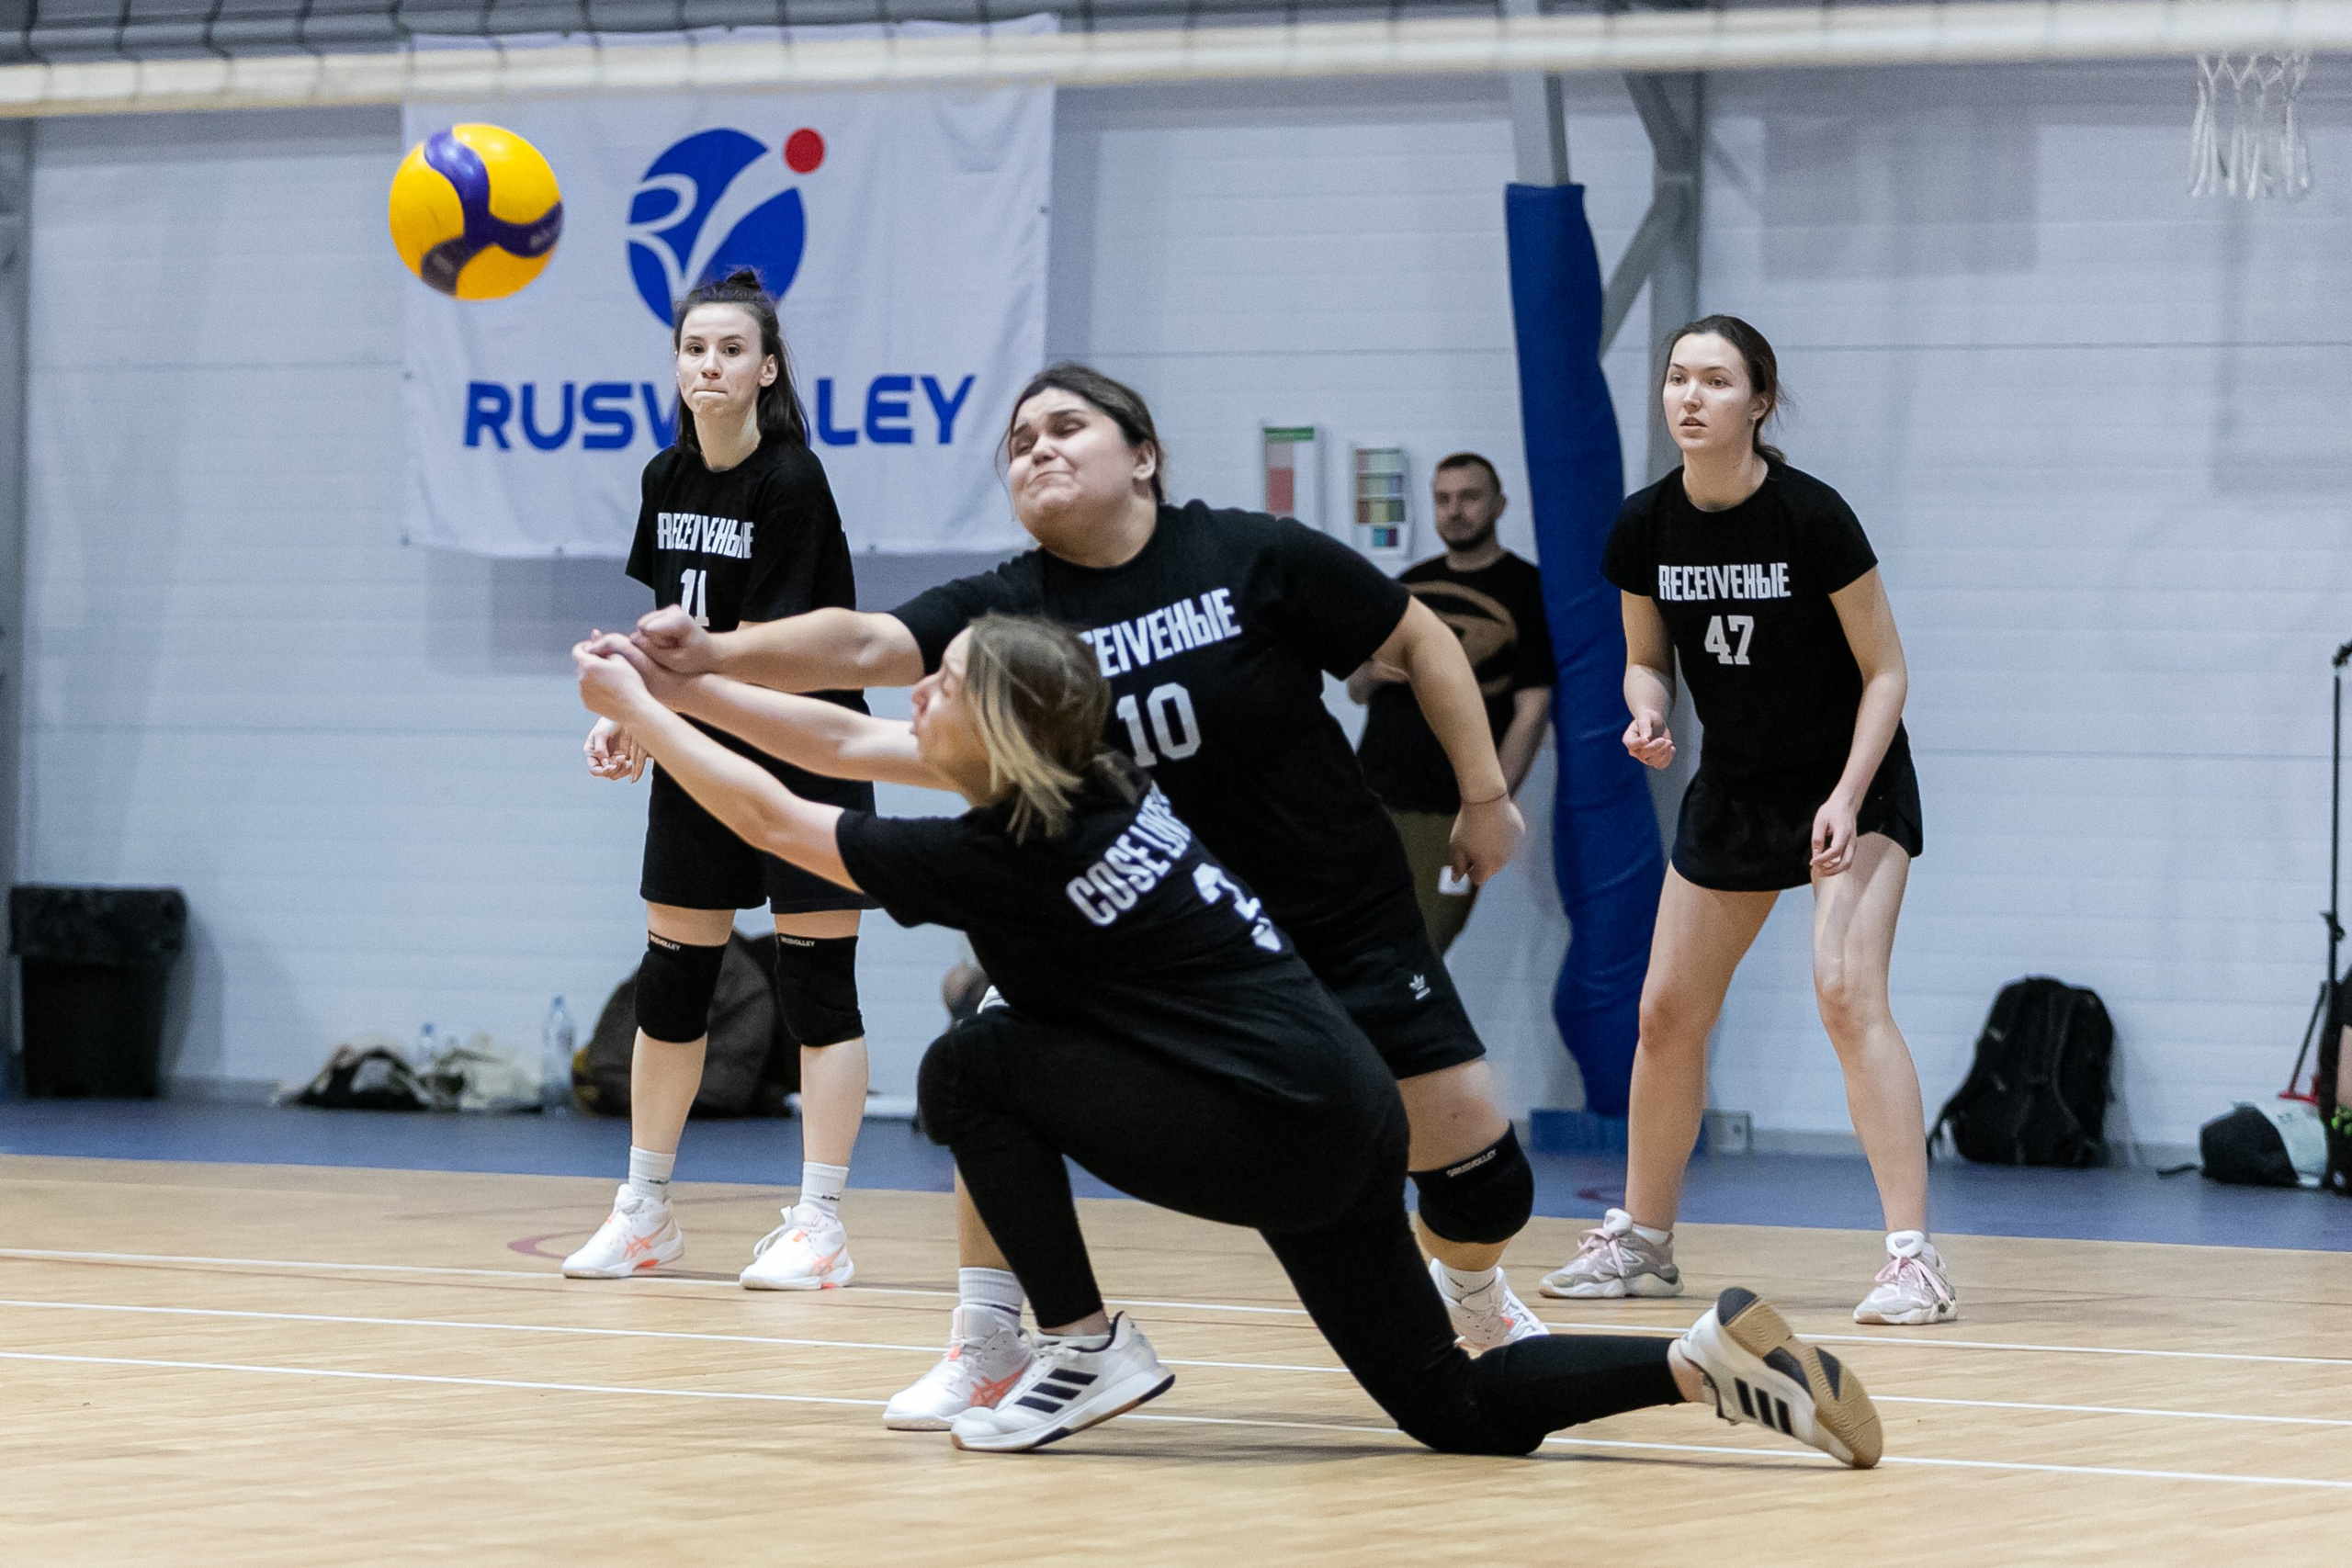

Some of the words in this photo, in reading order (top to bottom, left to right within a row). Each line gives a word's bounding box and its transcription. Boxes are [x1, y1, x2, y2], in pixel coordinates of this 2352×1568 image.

[465, 374, 977, 451] RUSVLEY
[1704, 615, 1754, 665] 47
[1115, 682, 1202, 768] 10
